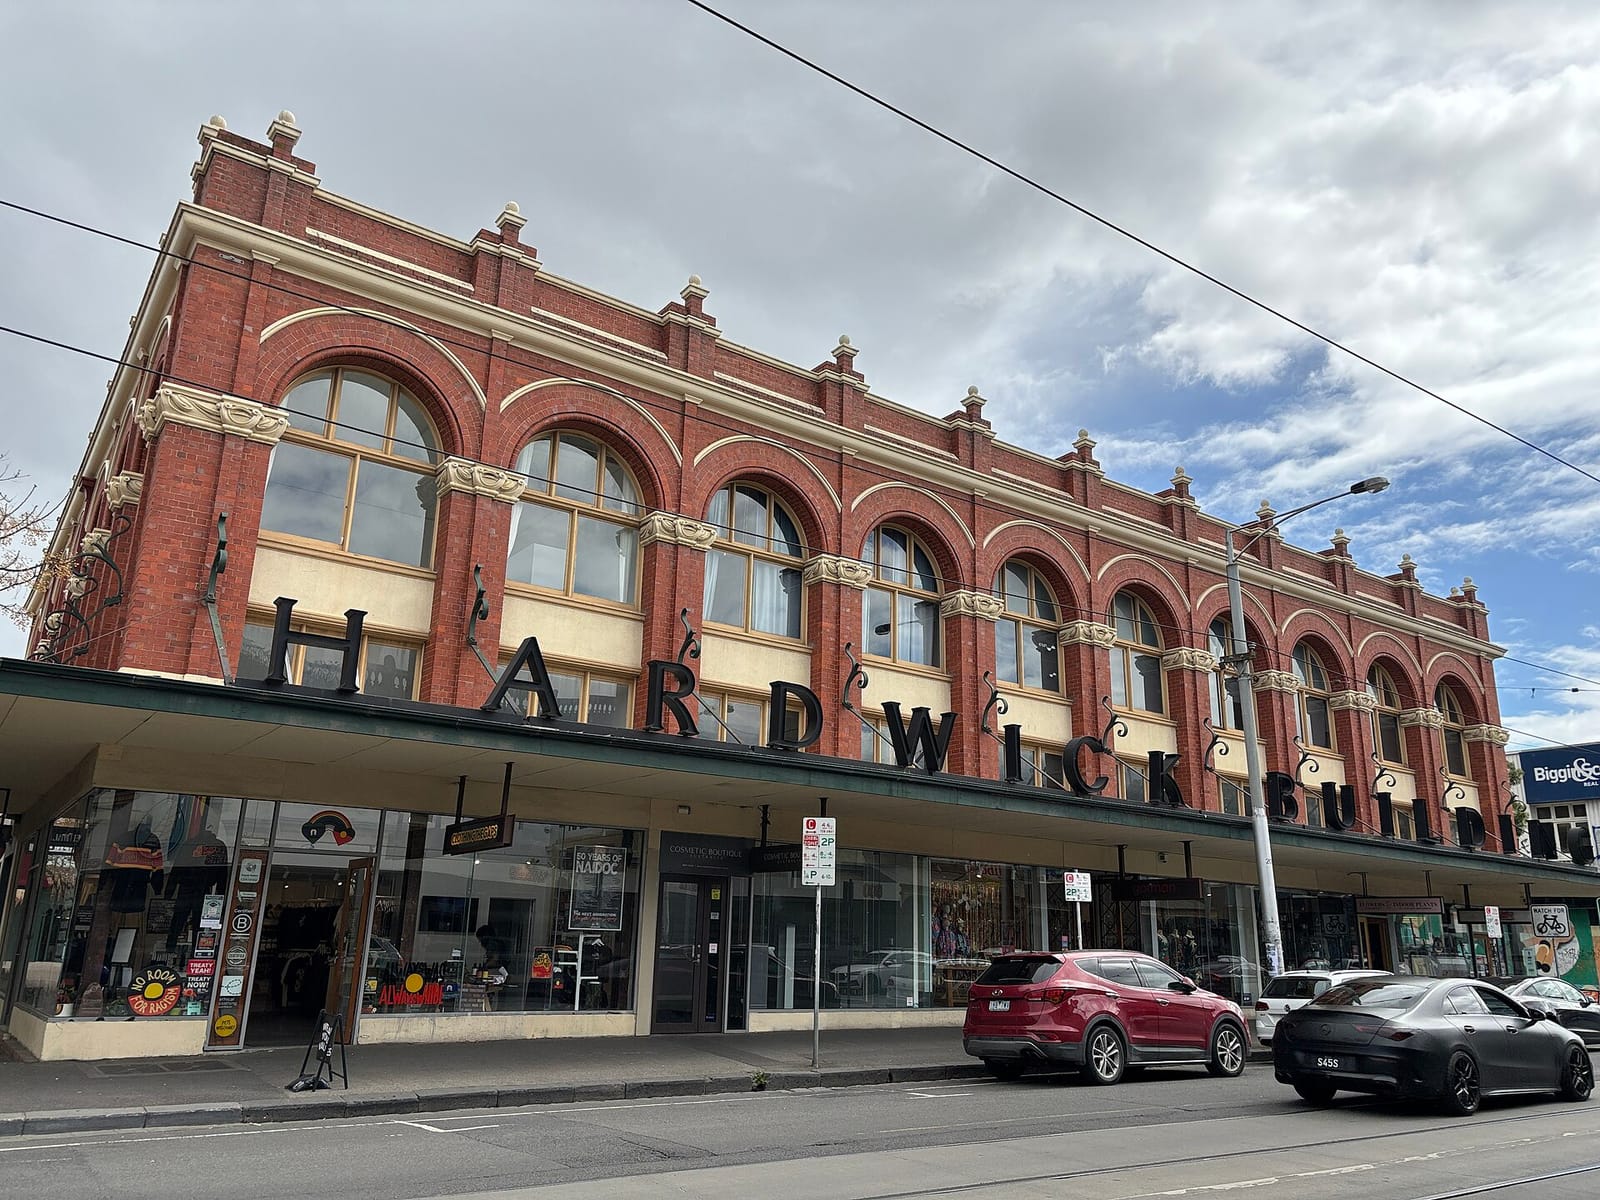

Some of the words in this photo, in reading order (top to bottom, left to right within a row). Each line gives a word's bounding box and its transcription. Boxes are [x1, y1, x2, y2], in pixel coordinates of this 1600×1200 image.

[264, 597, 1186, 808] HARDWICK
[1266, 771, 1594, 866] BUILDING
[821, 838, 834, 846] 2P
[576, 852, 586, 860] 50
[588, 853, 610, 862] YEARS
[612, 854, 623, 862] OF
[669, 845, 708, 856] COSMETIC
[708, 848, 742, 858] BOUTIQUE
[575, 860, 618, 875] NAIDOC
[1066, 888, 1077, 896] 2P
[131, 976, 146, 991] NO
[147, 969, 176, 984] ROOM
[131, 994, 149, 1013] FOR
[149, 987, 179, 1013] RACISM
[1317, 1057, 1339, 1068] S45S
